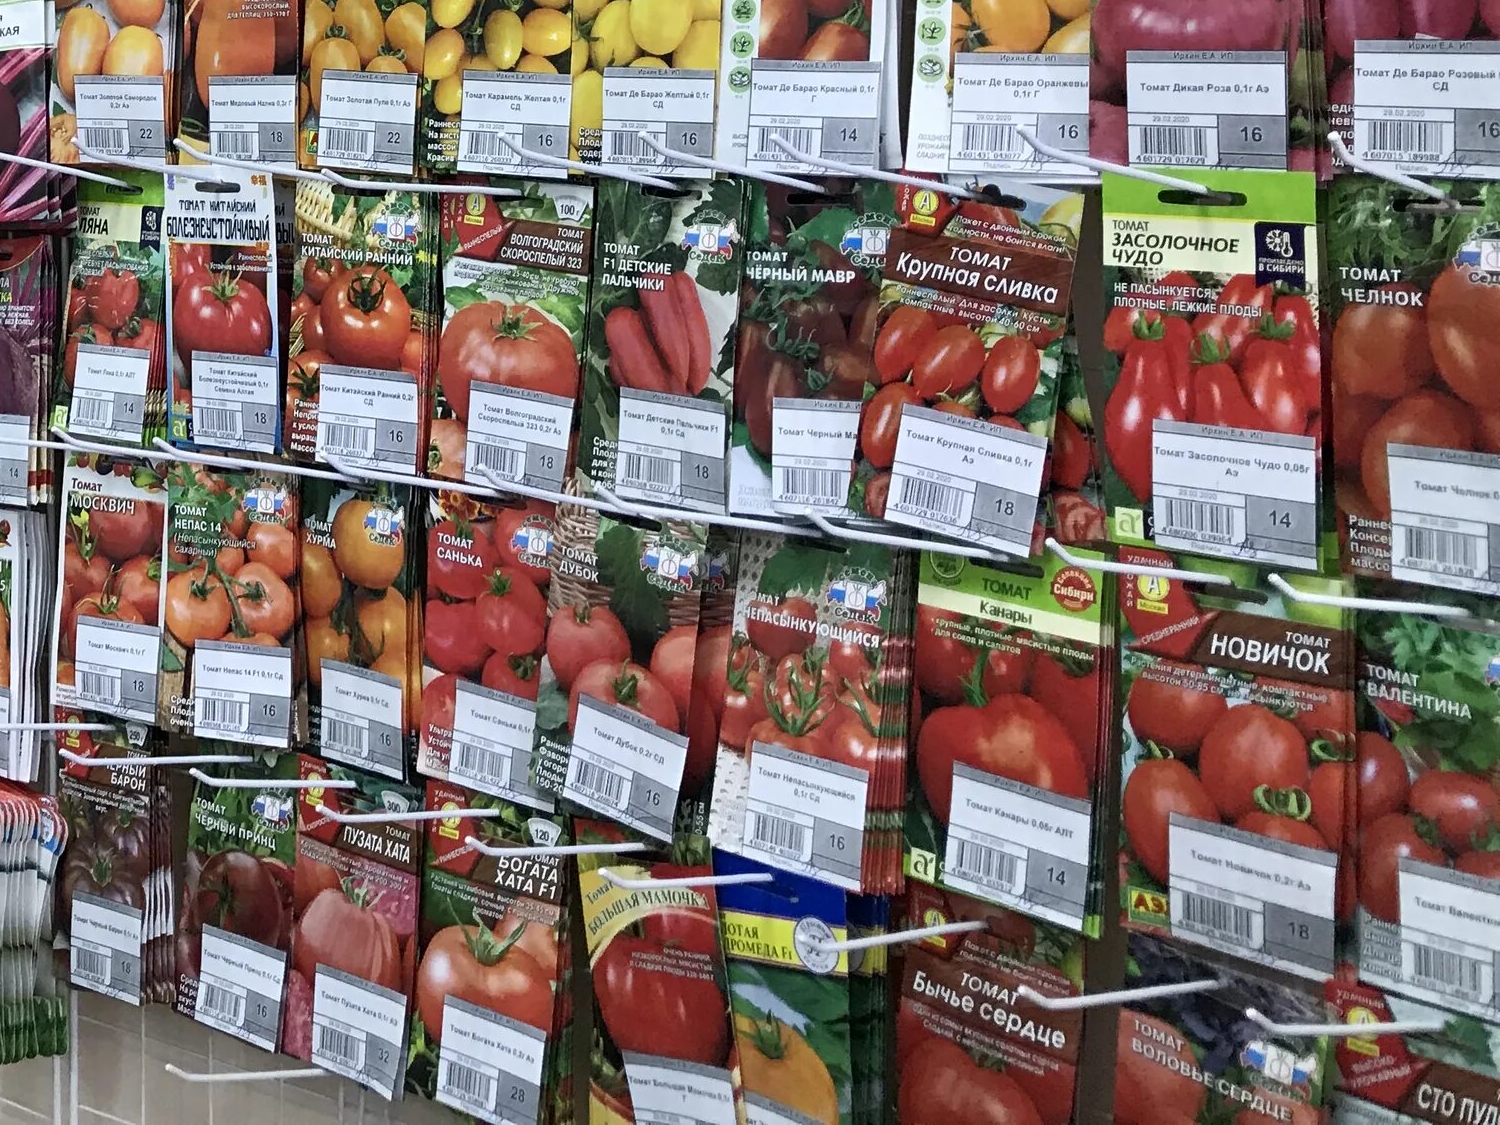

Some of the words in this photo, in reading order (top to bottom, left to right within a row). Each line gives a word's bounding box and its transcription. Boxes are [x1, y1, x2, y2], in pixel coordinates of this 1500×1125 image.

[1139, 83, 1169, 93] Томат
[1172, 83, 1202, 94] Дикая
[1206, 84, 1230, 95] Роза
[1112, 232, 1239, 253] ЗАСОЛОЧНОЕ
[301, 246, 362, 261] КИТАЙСКИЙ
[366, 251, 413, 265] РАННИЙ
[1112, 249, 1163, 266] ЧУДО
[604, 259, 615, 272] F1
[618, 260, 672, 274] ДЕТСКИЕ
[747, 265, 808, 281] ЧЁРНЫЙ
[811, 269, 855, 283] МАВР
[897, 252, 980, 287] Крупная
[1340, 266, 1401, 282] ТОМАТ
[602, 274, 664, 291] ПАЛЬЧИКИ
[1113, 282, 1128, 294] НЕ
[1341, 288, 1424, 307] ЧЕЛНОК
[1172, 300, 1217, 313] ЛЕЖКИЕ
[1220, 304, 1262, 317] ПЛОДЫ
[69, 494, 135, 515] МОСКВИЧ
[174, 518, 207, 532] НЕПАС
[210, 519, 221, 531] 14
[306, 534, 336, 549] ХУРМА
[436, 547, 483, 568] САНЬКА
[560, 559, 599, 582] ДУБОК
[979, 599, 1032, 625] Канары
[1210, 633, 1330, 674] НОВИЧОК
[1367, 682, 1472, 719] ВАЛЕНТИНА
[239, 827, 277, 850] ПРИНЦ
[343, 827, 378, 855] ПУЗАТА
[381, 839, 411, 863] ХАТА
[498, 855, 558, 883] БОГАТА
[913, 973, 974, 1013] Бычье
[1132, 1039, 1214, 1086] ВОЛОВЬЕ
[1218, 1079, 1292, 1120] СЕРДЦЕ
